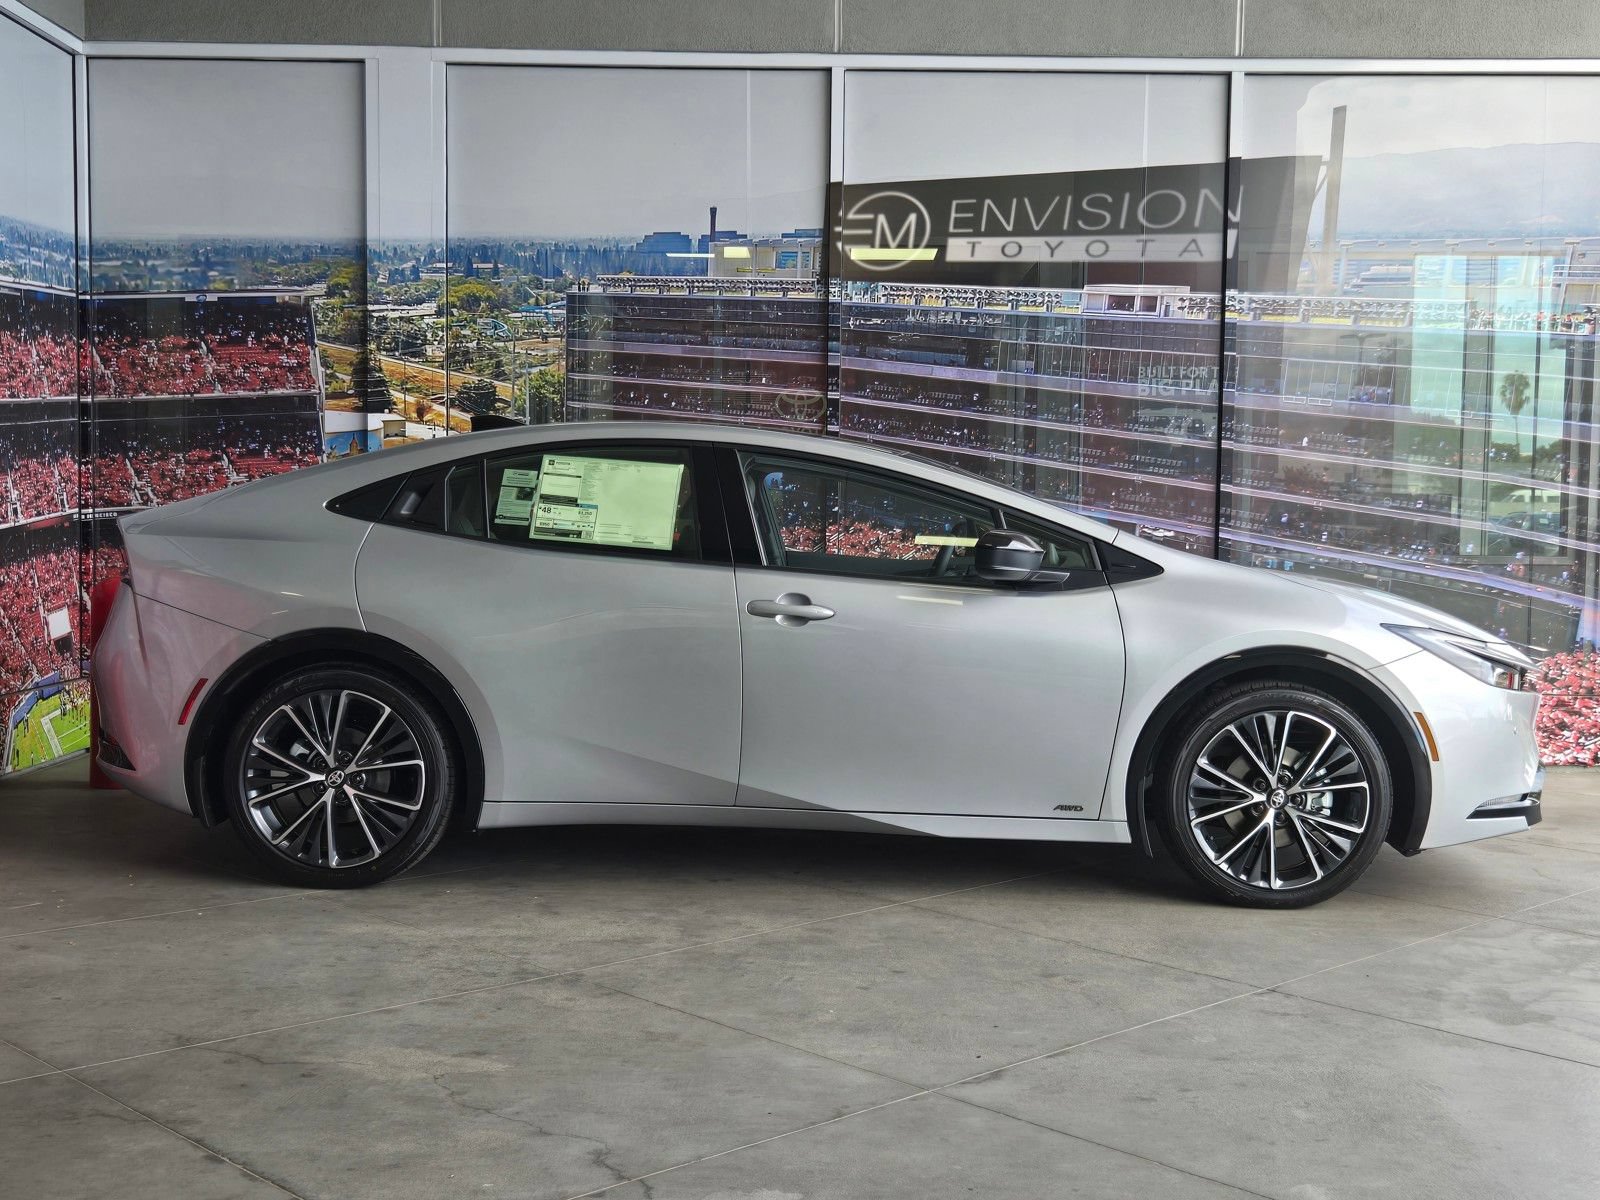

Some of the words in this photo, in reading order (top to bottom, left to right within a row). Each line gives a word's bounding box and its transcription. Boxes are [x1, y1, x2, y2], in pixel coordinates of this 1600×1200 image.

[948, 185, 1244, 233] ENVISION
[966, 238, 1204, 258] TOYOTA
[1138, 366, 1177, 378] BUILT
[1180, 366, 1208, 378] FOR
[1138, 379, 1175, 396] BIG
